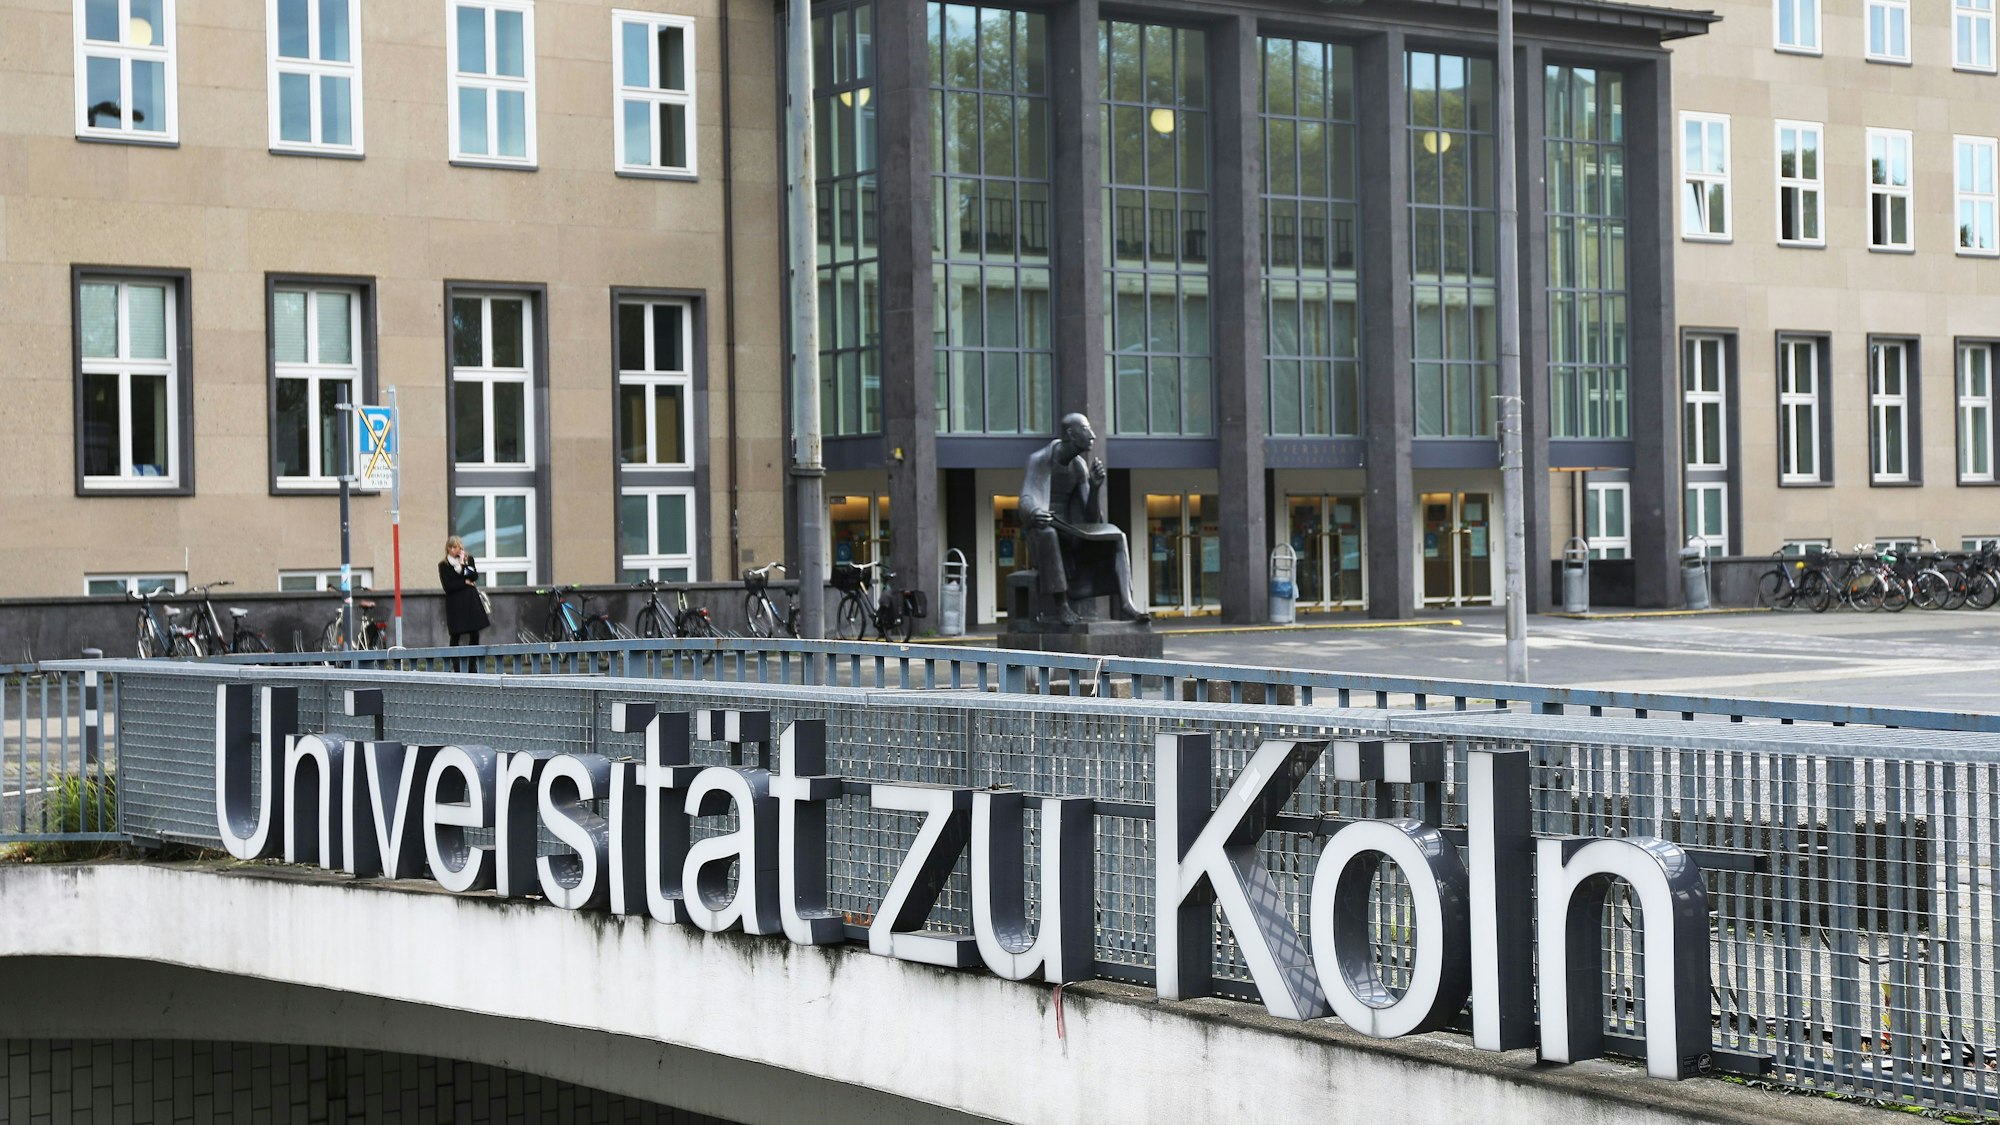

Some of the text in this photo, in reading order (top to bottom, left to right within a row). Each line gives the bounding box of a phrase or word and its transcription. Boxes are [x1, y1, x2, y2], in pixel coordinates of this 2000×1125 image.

[215, 683, 1690, 1081] Universität zu Köln
